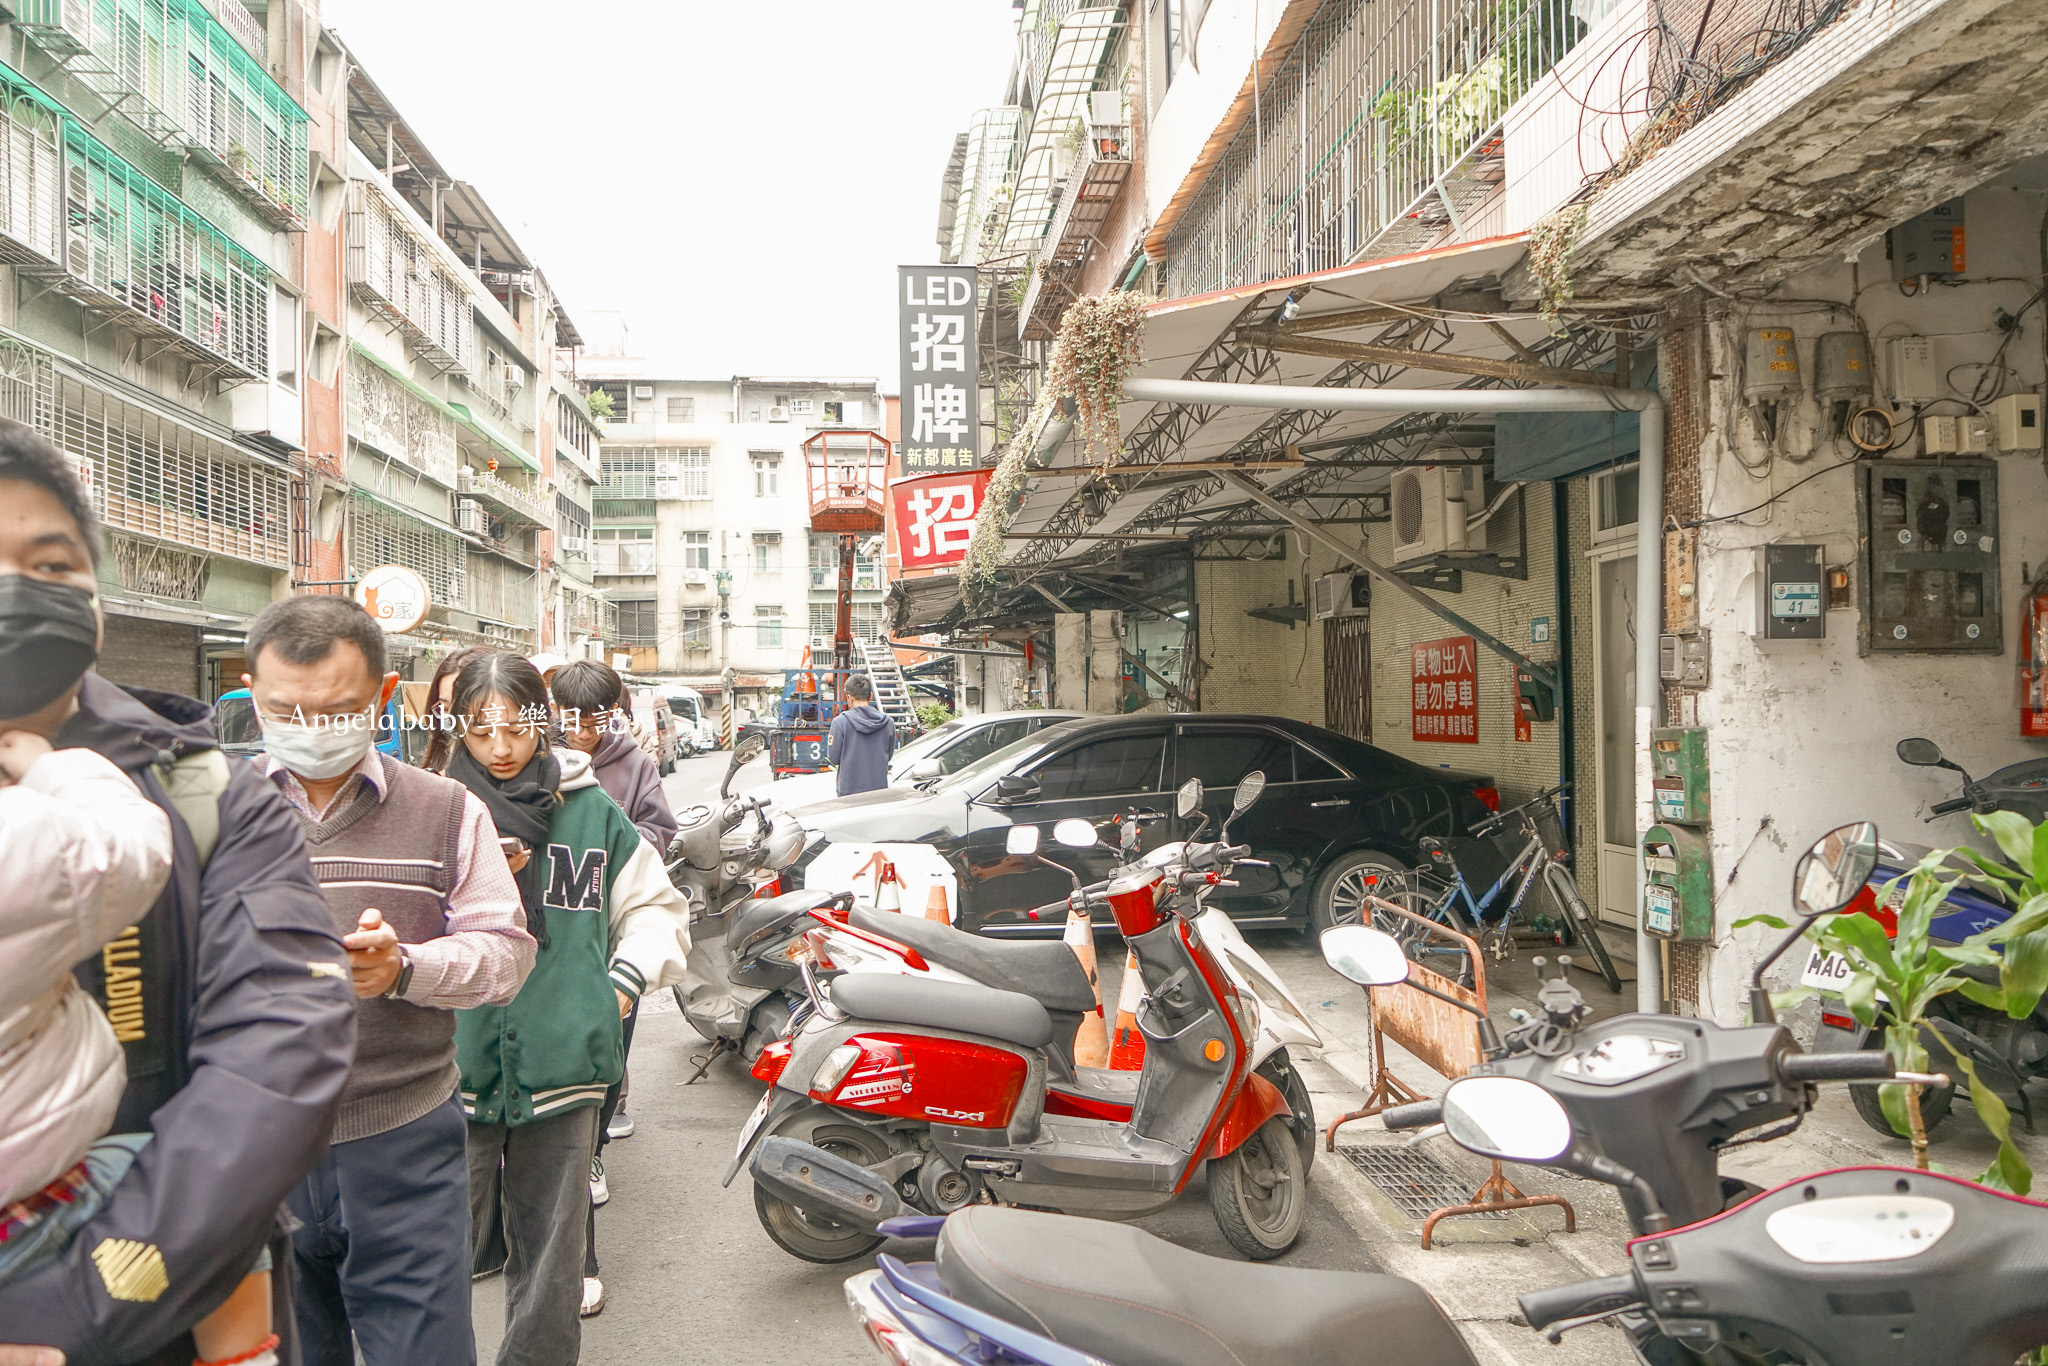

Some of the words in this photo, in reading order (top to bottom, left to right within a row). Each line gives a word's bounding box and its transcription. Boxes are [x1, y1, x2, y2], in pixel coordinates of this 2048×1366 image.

[906, 276, 972, 306] LED
[910, 312, 969, 444] 招牌
[906, 448, 974, 467] 新都廣告
[906, 485, 976, 557] 招
[1788, 600, 1804, 614] 41
[1414, 645, 1473, 678] 貨物出入
[1414, 678, 1474, 710] 請勿停車
[1672, 806, 1684, 819] 41
[543, 843, 608, 913] M
